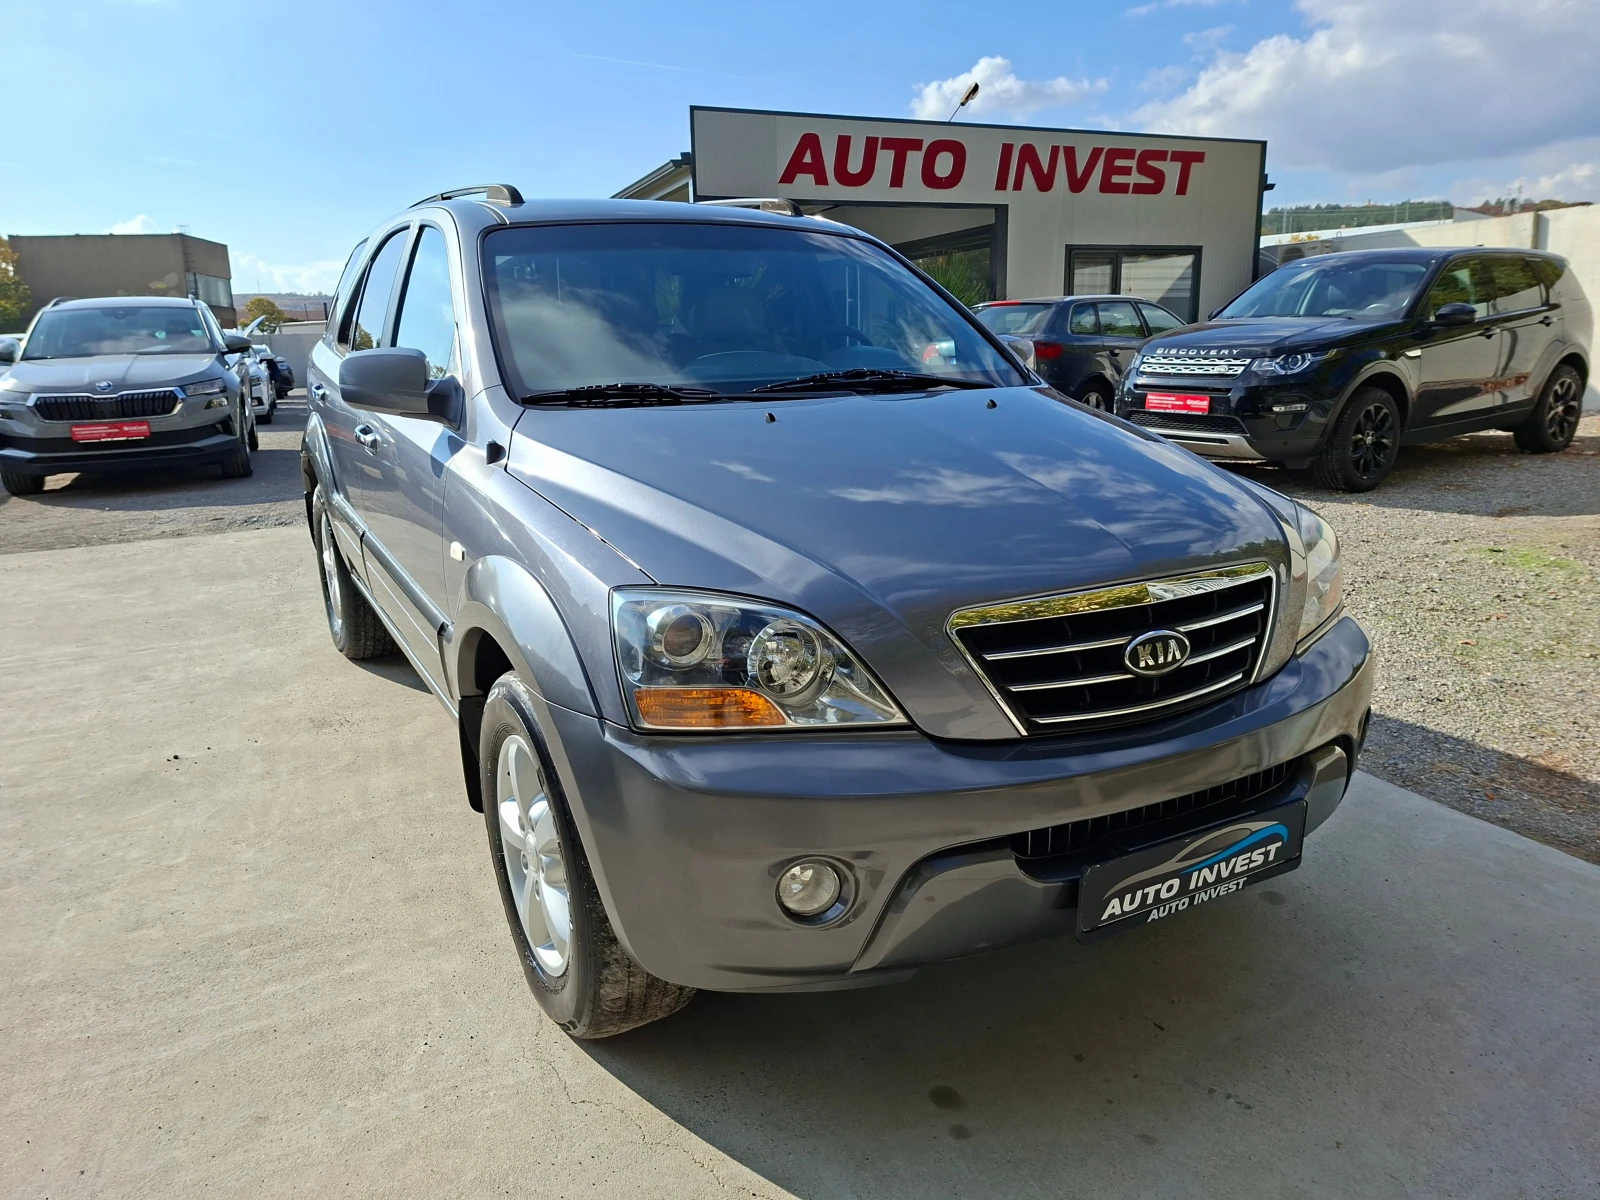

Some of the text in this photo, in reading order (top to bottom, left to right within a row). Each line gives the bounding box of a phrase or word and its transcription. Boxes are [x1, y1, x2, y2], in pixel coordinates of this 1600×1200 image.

[778, 132, 1206, 196] AUTO INVEST
[1156, 347, 1241, 355] DISCOVERY
[1136, 638, 1182, 668] KIA
[1101, 841, 1283, 921] AUTO INVEST
[1146, 877, 1248, 923] AUTO INVEST
